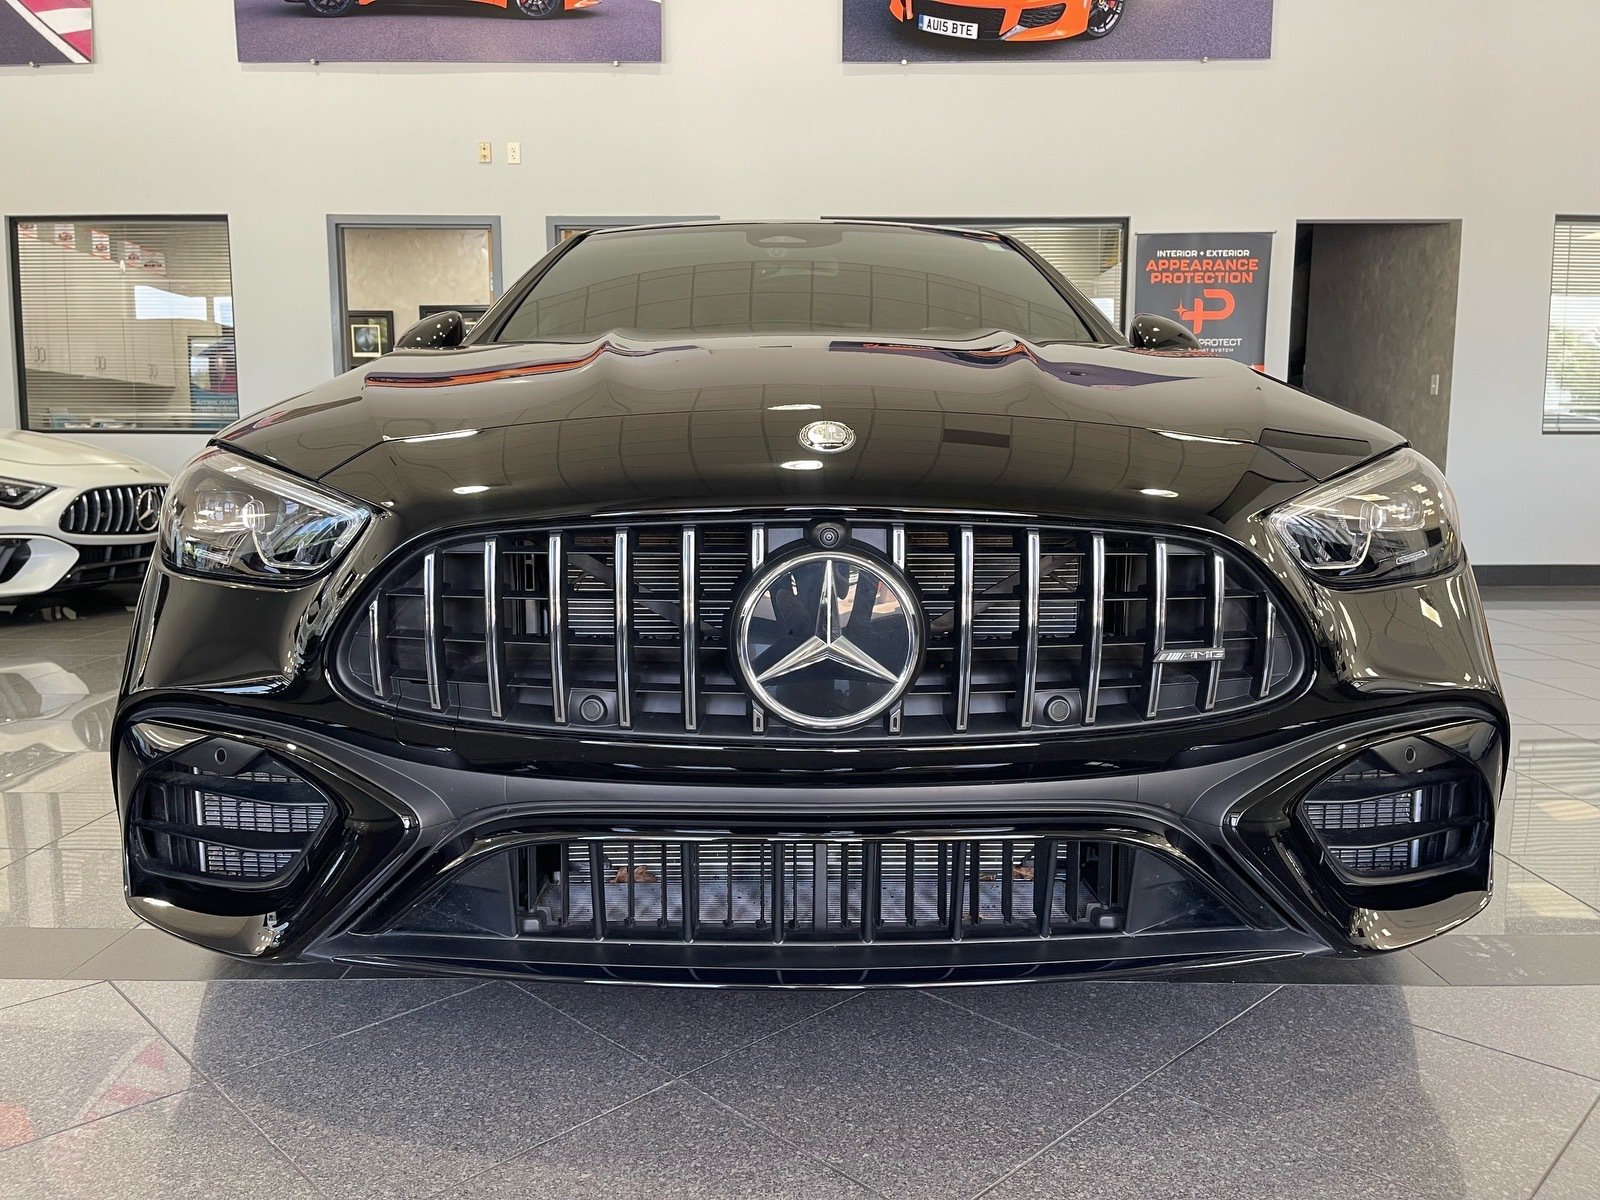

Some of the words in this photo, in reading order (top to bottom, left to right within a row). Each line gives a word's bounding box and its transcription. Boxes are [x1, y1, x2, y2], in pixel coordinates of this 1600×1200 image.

[951, 22, 974, 36] BTE
[1156, 249, 1198, 258] INTERIOR
[1205, 249, 1250, 257] EXTERIOR
[1145, 259, 1259, 271] APPEARANCE
[1150, 272, 1253, 284] PROTECTION
[1198, 338, 1243, 347] PROTECT
